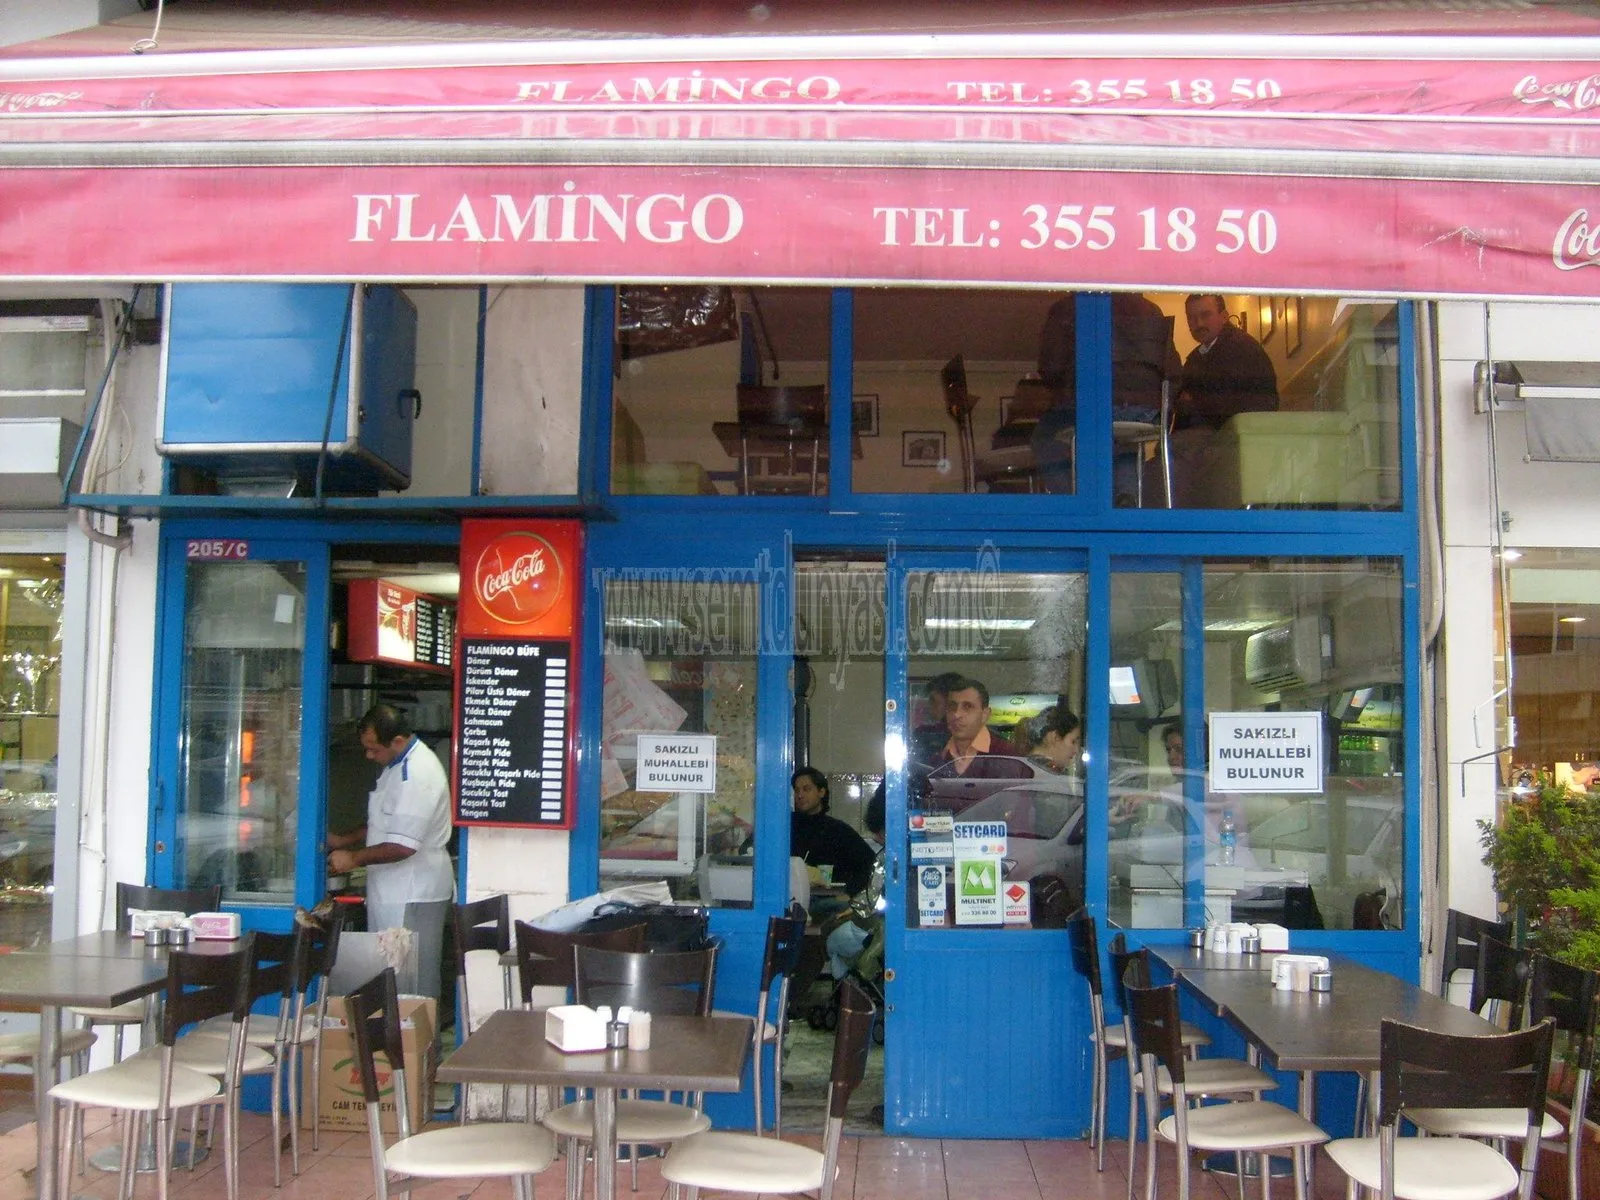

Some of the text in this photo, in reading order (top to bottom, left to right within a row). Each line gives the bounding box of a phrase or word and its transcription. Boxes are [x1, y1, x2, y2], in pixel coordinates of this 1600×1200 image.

[947, 78, 1282, 105] TEL: 355 18 50
[348, 180, 744, 244] FLAMİNGO
[873, 203, 1278, 255] TEL: 355 18 50
[187, 541, 248, 557] 205/C
[483, 548, 545, 601] Coca-Cola
[517, 645, 540, 657] BÜFE
[466, 657, 491, 665] Döner
[466, 667, 519, 676] Dürüm Döner
[465, 686, 531, 697] Pilav Üstü Döner
[465, 697, 517, 706] Ekmek Döner
[488, 708, 512, 716] Döner
[464, 717, 503, 726] Lahmacun
[1233, 728, 1296, 739] SAKIZLI
[492, 738, 511, 747] Pide
[494, 748, 512, 757] Pide
[655, 745, 699, 755] SAKIZLI
[1219, 745, 1311, 759] MUHALLEBİ
[491, 759, 510, 767] Pide
[644, 758, 709, 769] MUHALLEBİ
[523, 770, 541, 779] Pide
[649, 773, 704, 783] BULUNUR
[1227, 767, 1305, 779] BULUNUR
[498, 779, 517, 788] Pide
[493, 789, 509, 798] Tost
[490, 799, 507, 808] Tost
[954, 824, 1006, 839] SETCARD
[920, 909, 944, 917] SETCARD
